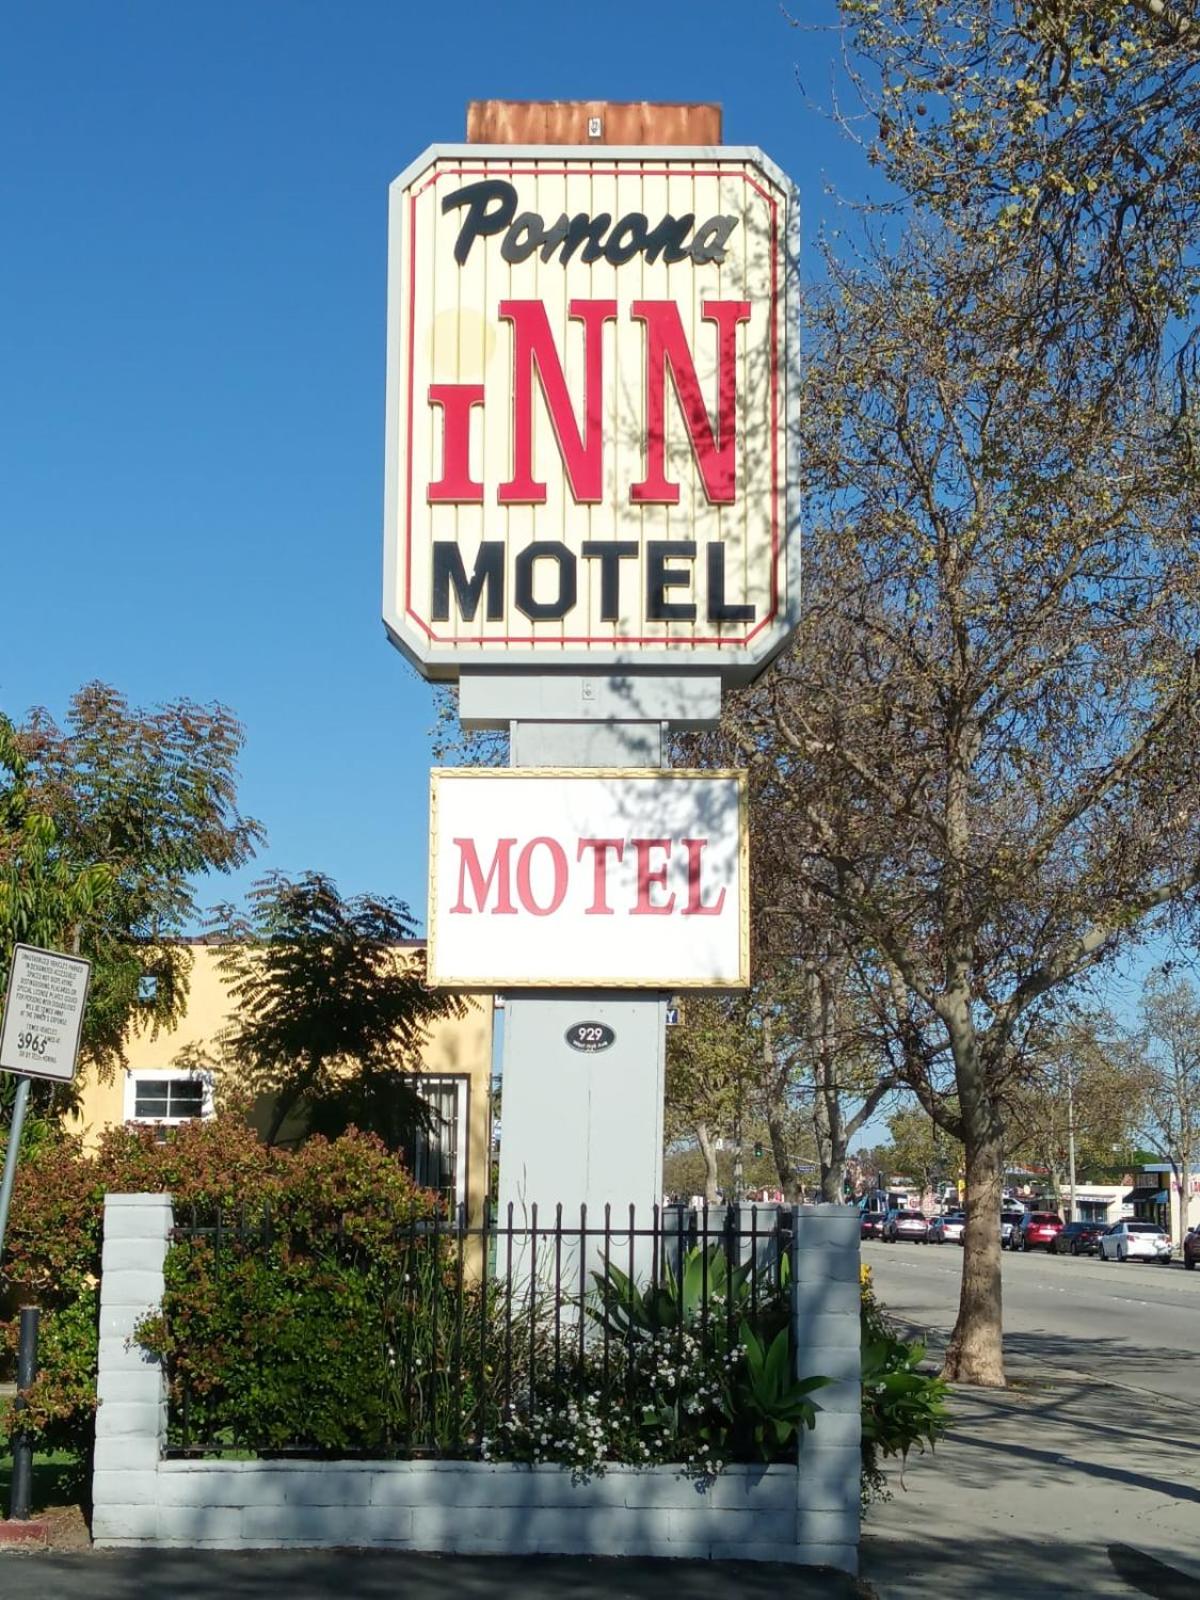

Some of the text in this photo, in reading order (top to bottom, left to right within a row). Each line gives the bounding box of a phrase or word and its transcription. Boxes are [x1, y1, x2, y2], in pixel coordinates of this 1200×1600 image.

[441, 179, 740, 267] Pomona
[426, 299, 752, 505] INN
[431, 541, 756, 623] MOTEL
[449, 836, 727, 917] MOTEL
[17, 1032, 48, 1055] 3965
[578, 1027, 603, 1041] 929
